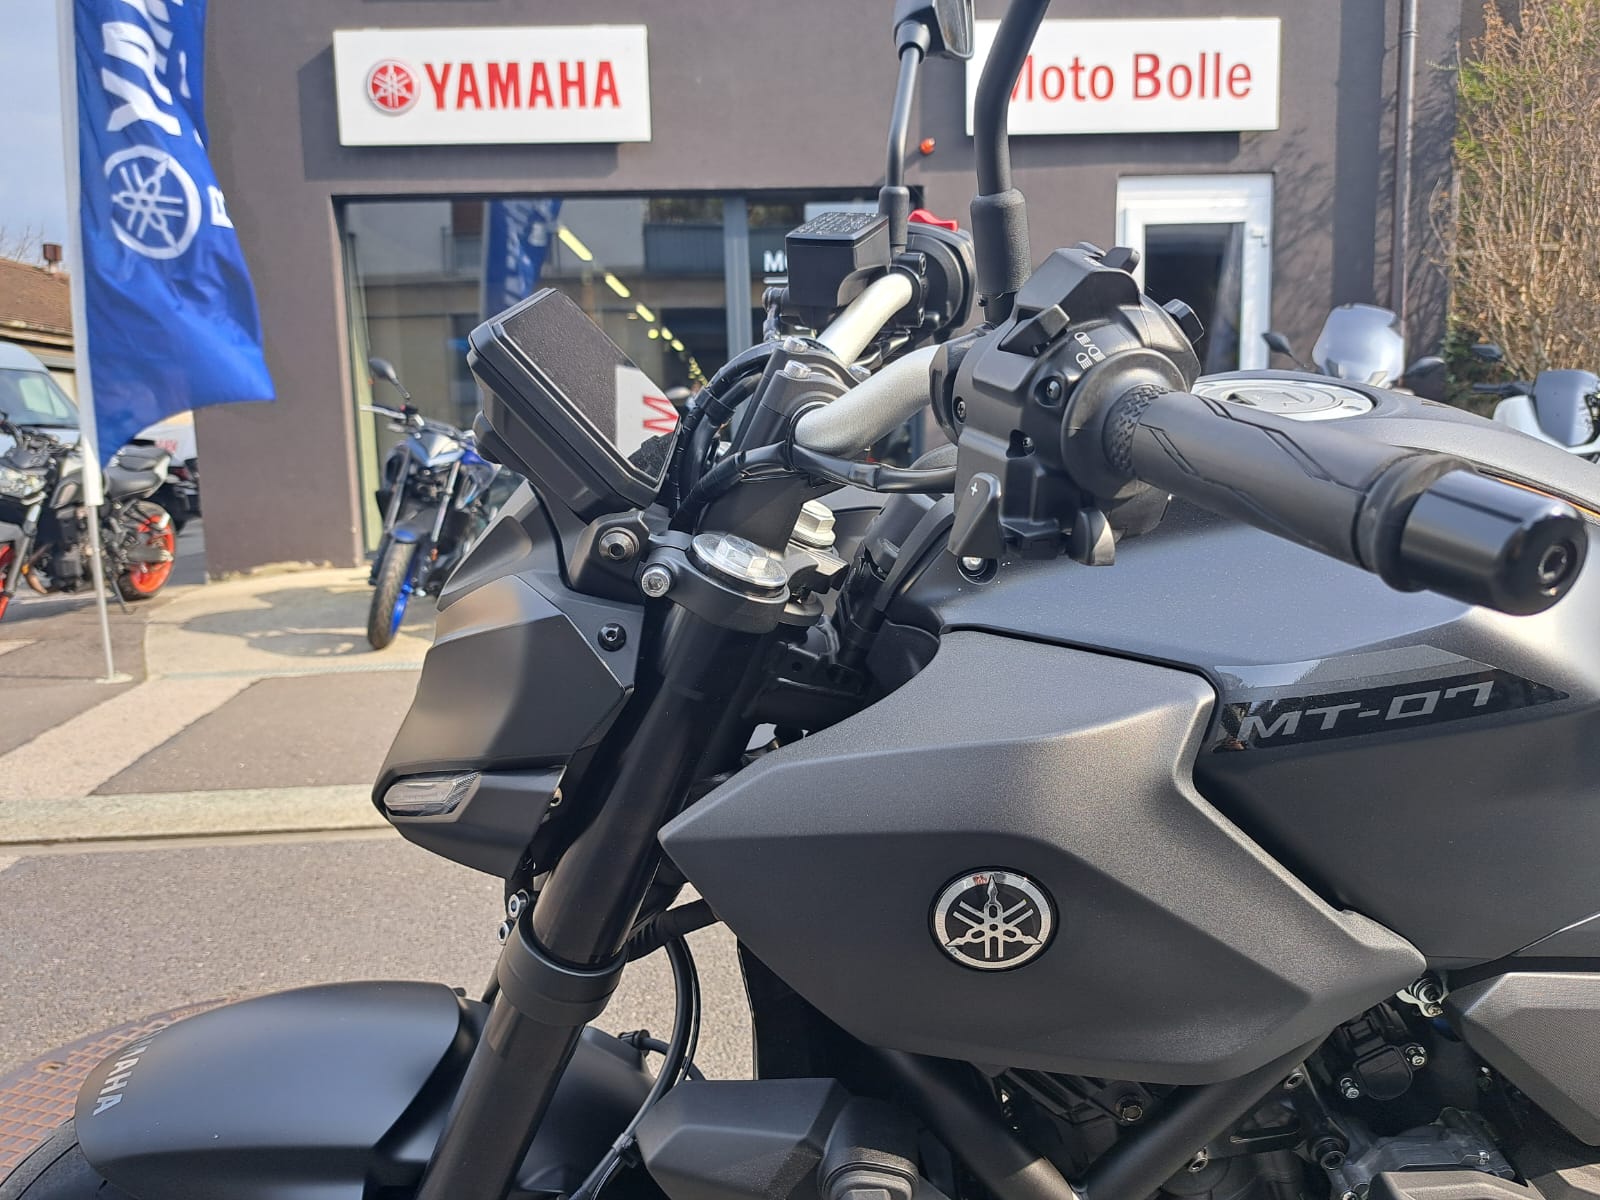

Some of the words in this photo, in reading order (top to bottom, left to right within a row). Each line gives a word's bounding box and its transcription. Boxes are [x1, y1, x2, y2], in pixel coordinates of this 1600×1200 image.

[424, 61, 621, 110] YAMAHA
[1132, 52, 1252, 99] Bolle
[763, 250, 788, 272] M
[1237, 680, 1495, 741] MT-07
